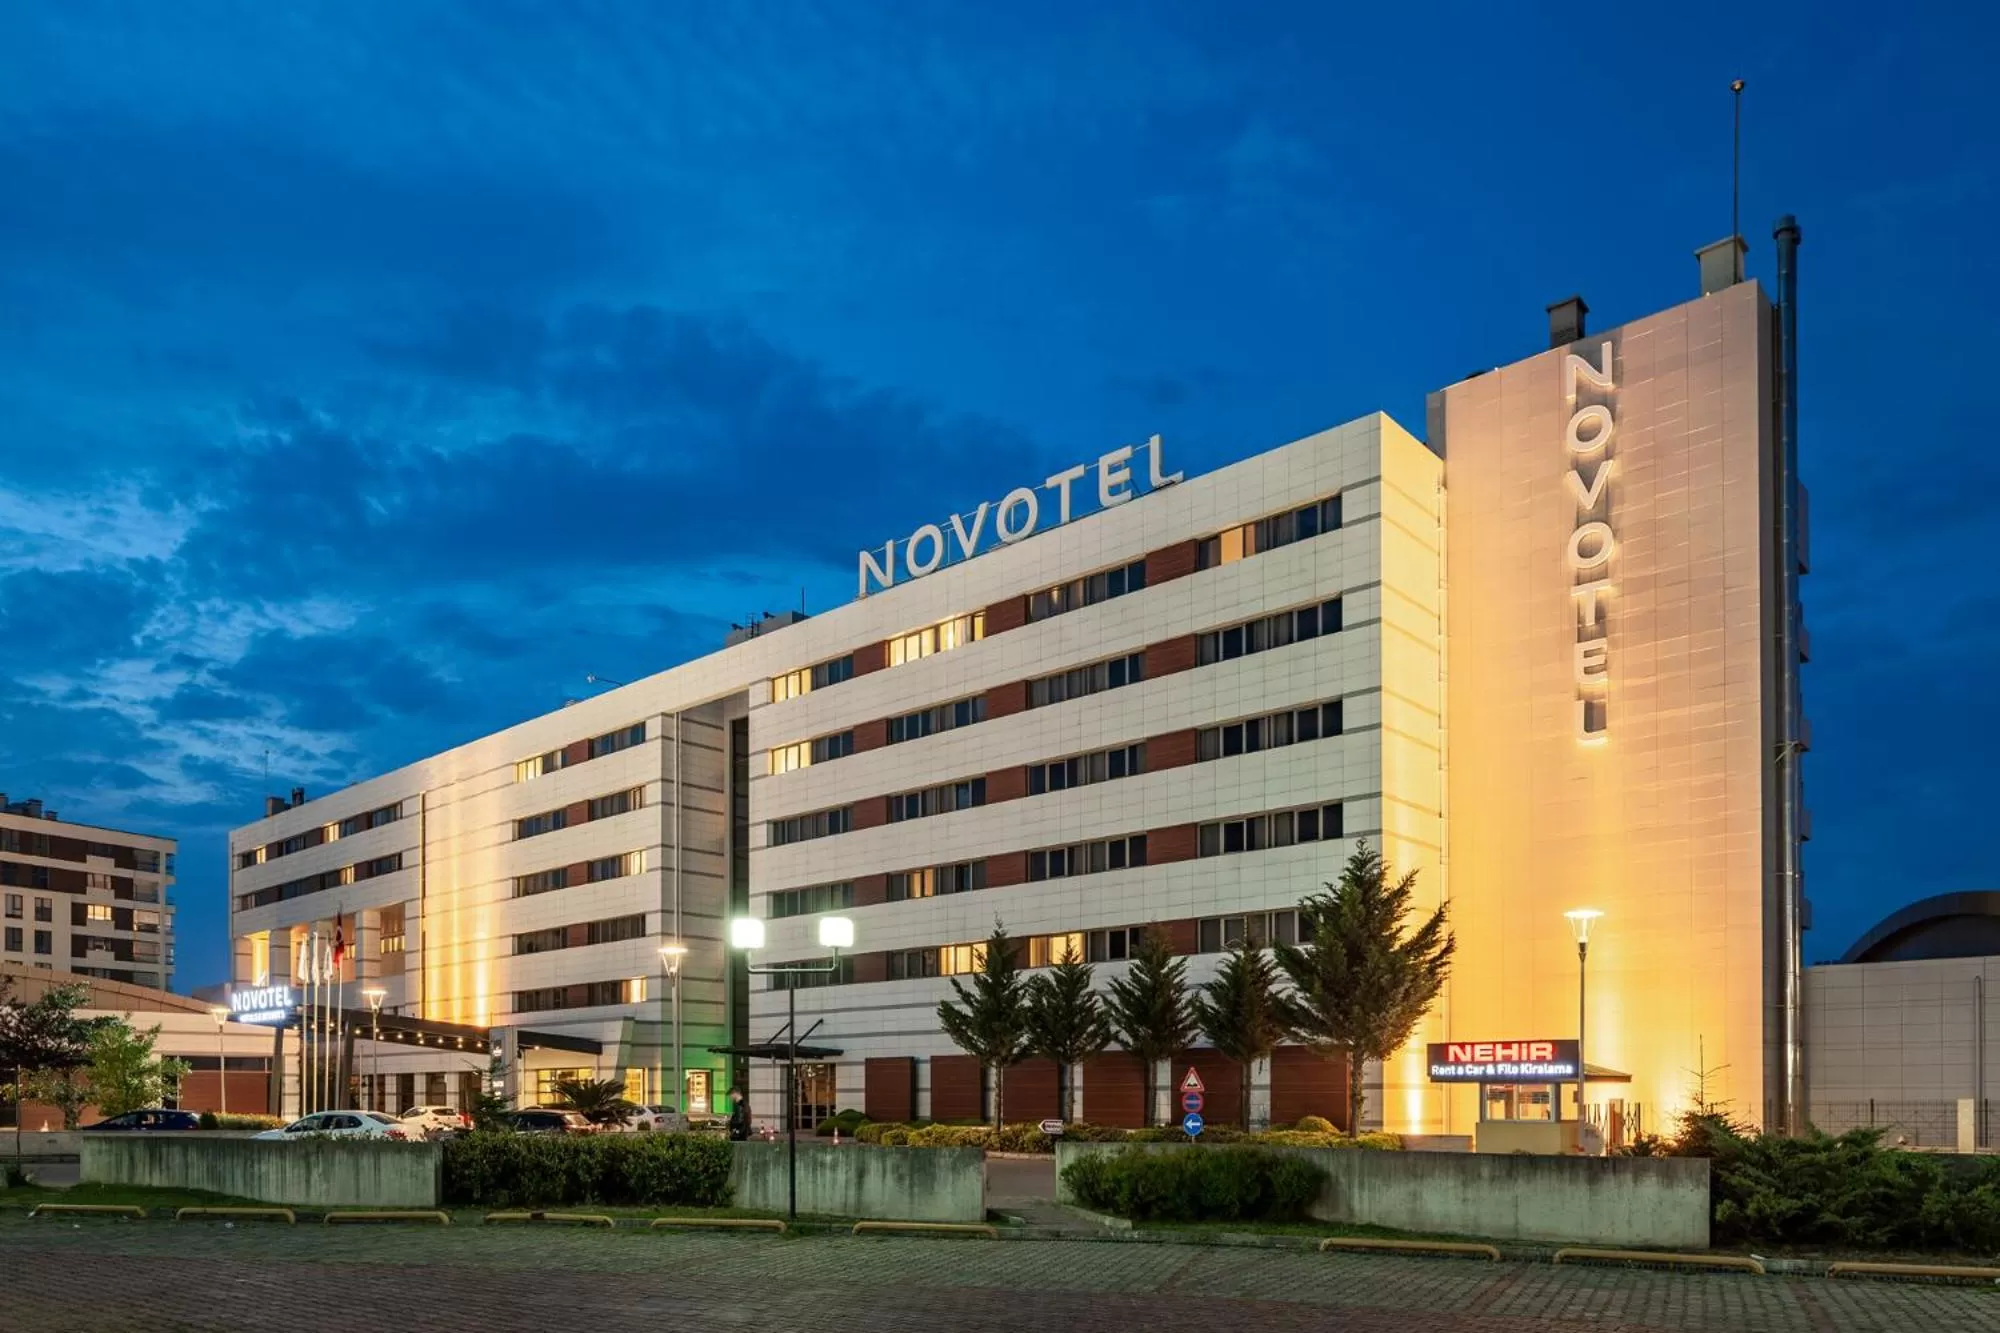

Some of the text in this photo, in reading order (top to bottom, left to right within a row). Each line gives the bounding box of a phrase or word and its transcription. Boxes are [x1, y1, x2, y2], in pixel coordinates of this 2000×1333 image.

[859, 434, 1184, 598] NOVOTEL
[1566, 340, 1616, 744] NOVOTEL
[231, 986, 292, 1012] NOVOTEL
[1431, 1065, 1456, 1076] Rent
[1465, 1064, 1485, 1075] Car
[1486, 1064, 1495, 1075] &
[1497, 1063, 1519, 1075] Filo
[1520, 1063, 1573, 1075] Kiralama
